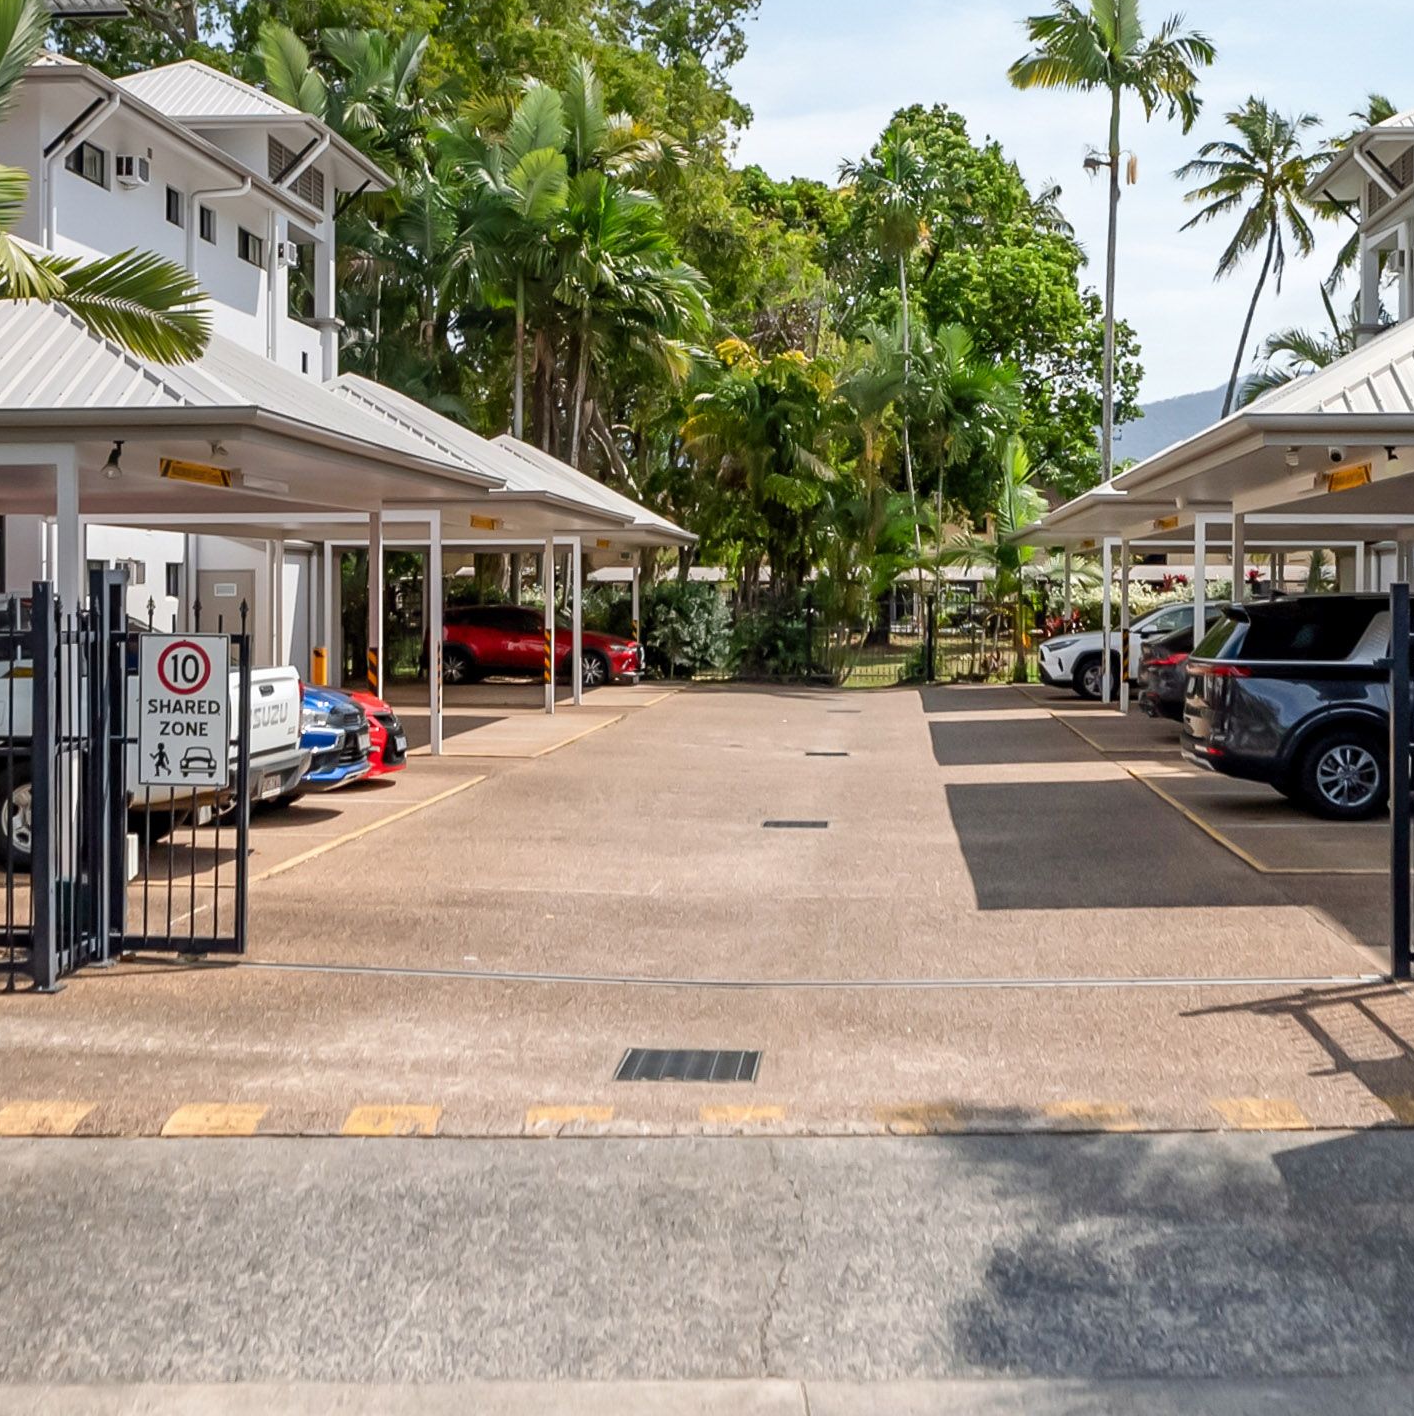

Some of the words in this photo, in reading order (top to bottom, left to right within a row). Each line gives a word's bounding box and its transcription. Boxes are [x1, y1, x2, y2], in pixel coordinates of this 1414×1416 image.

[171, 654, 200, 684] 10
[147, 699, 221, 716] SHARED
[251, 701, 289, 730] SUZU
[159, 721, 208, 737] ZONE
